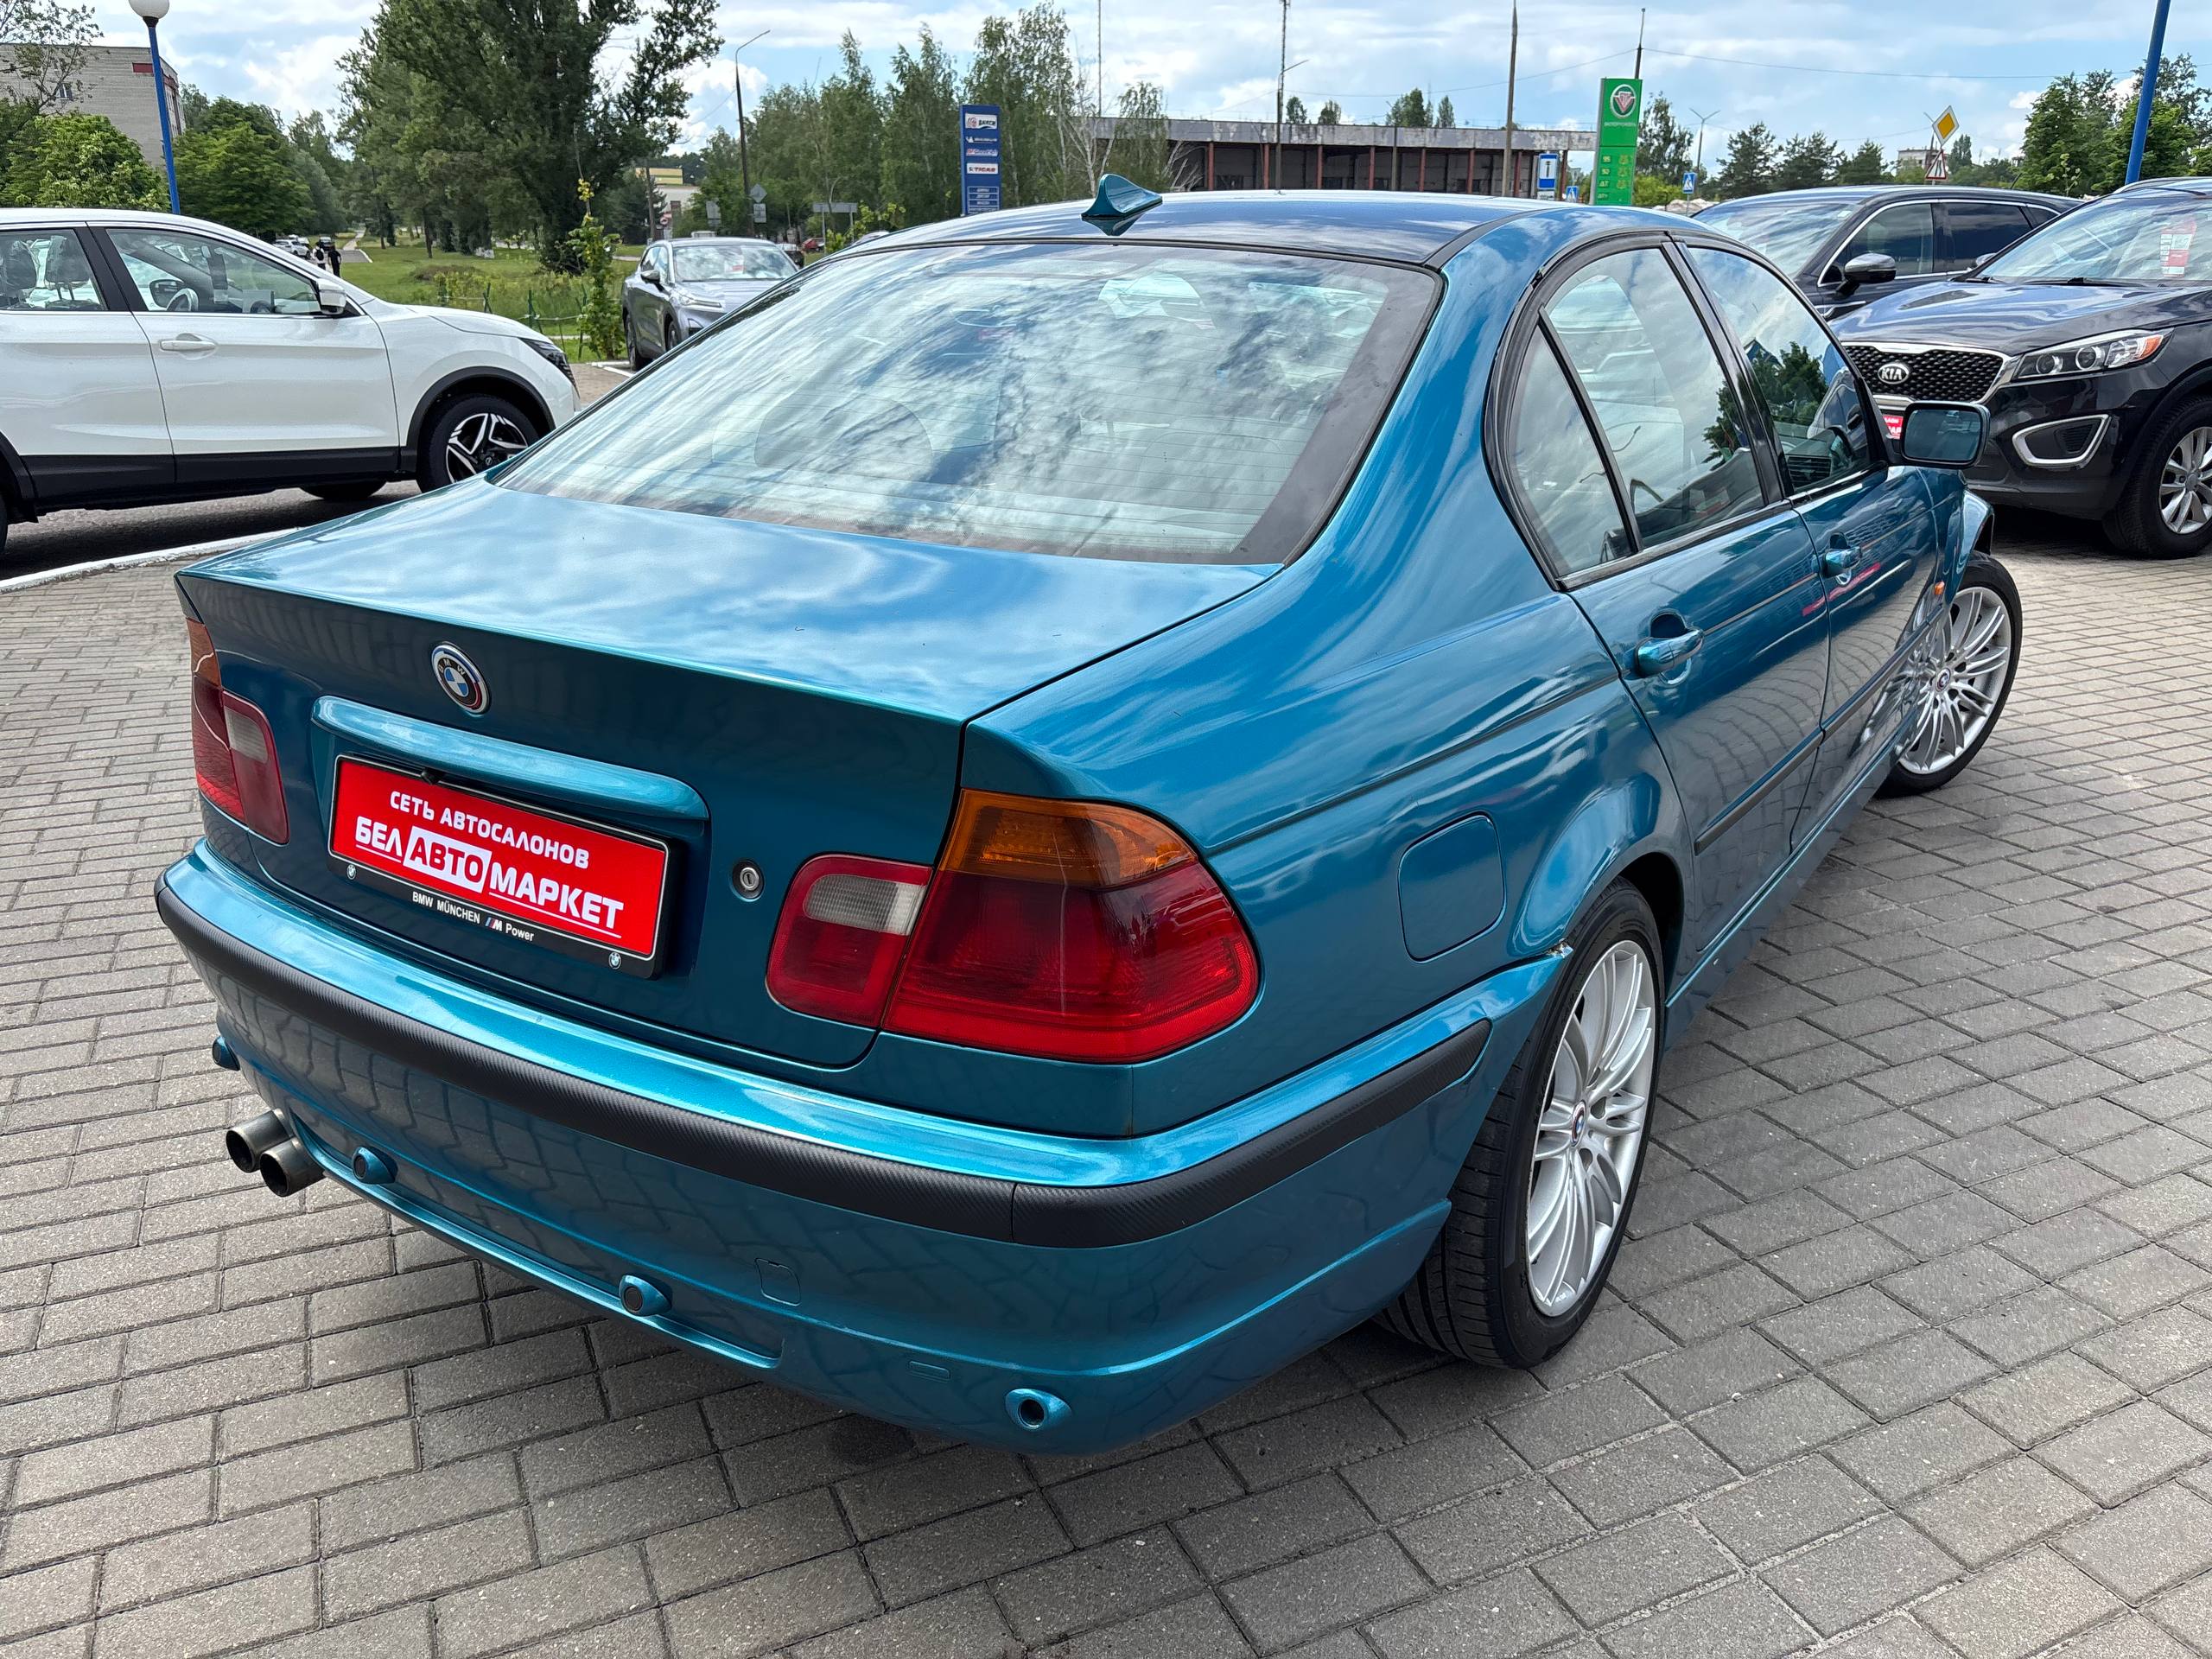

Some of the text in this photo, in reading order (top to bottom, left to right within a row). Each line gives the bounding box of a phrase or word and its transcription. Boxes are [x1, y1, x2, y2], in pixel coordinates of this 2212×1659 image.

[1881, 367, 1903, 381] KIA
[438, 658, 467, 676] BMW
[390, 790, 589, 870] СЕТЬ АВТОСАЛОНОВ
[412, 891, 434, 908] BMW
[436, 899, 480, 925] MÜNCHEN
[505, 923, 535, 942] Power
